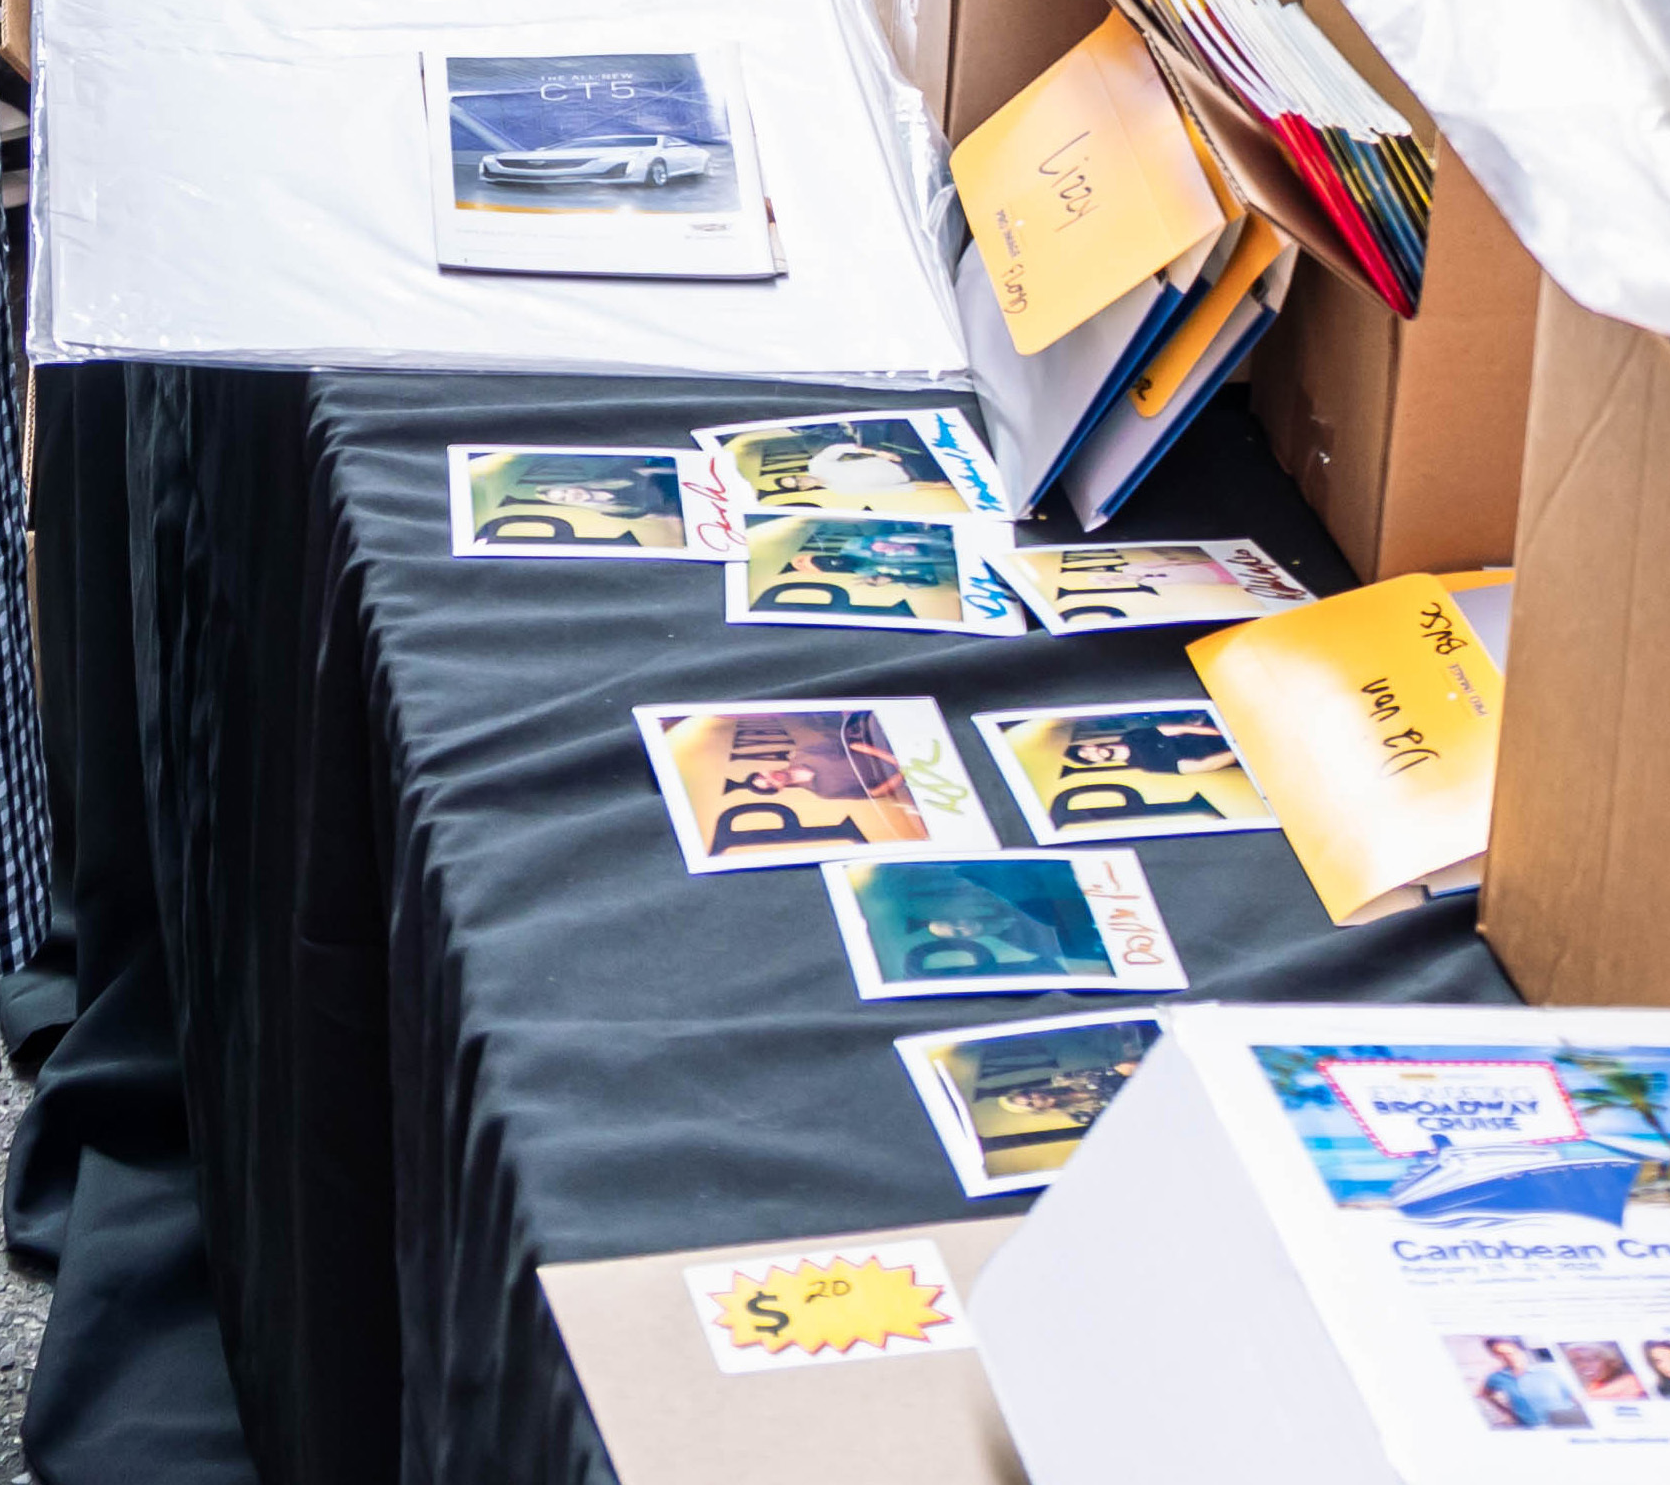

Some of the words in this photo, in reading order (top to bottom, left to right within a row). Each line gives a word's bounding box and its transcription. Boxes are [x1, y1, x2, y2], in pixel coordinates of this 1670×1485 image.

[539, 81, 636, 102] CT5
[1038, 130, 1102, 232] Lizzy
[1372, 1100, 1539, 1116] BROADWAY
[1416, 1116, 1521, 1132] CRUISE
[1391, 1237, 1607, 1263] Caribbean
[745, 1290, 792, 1338] $
